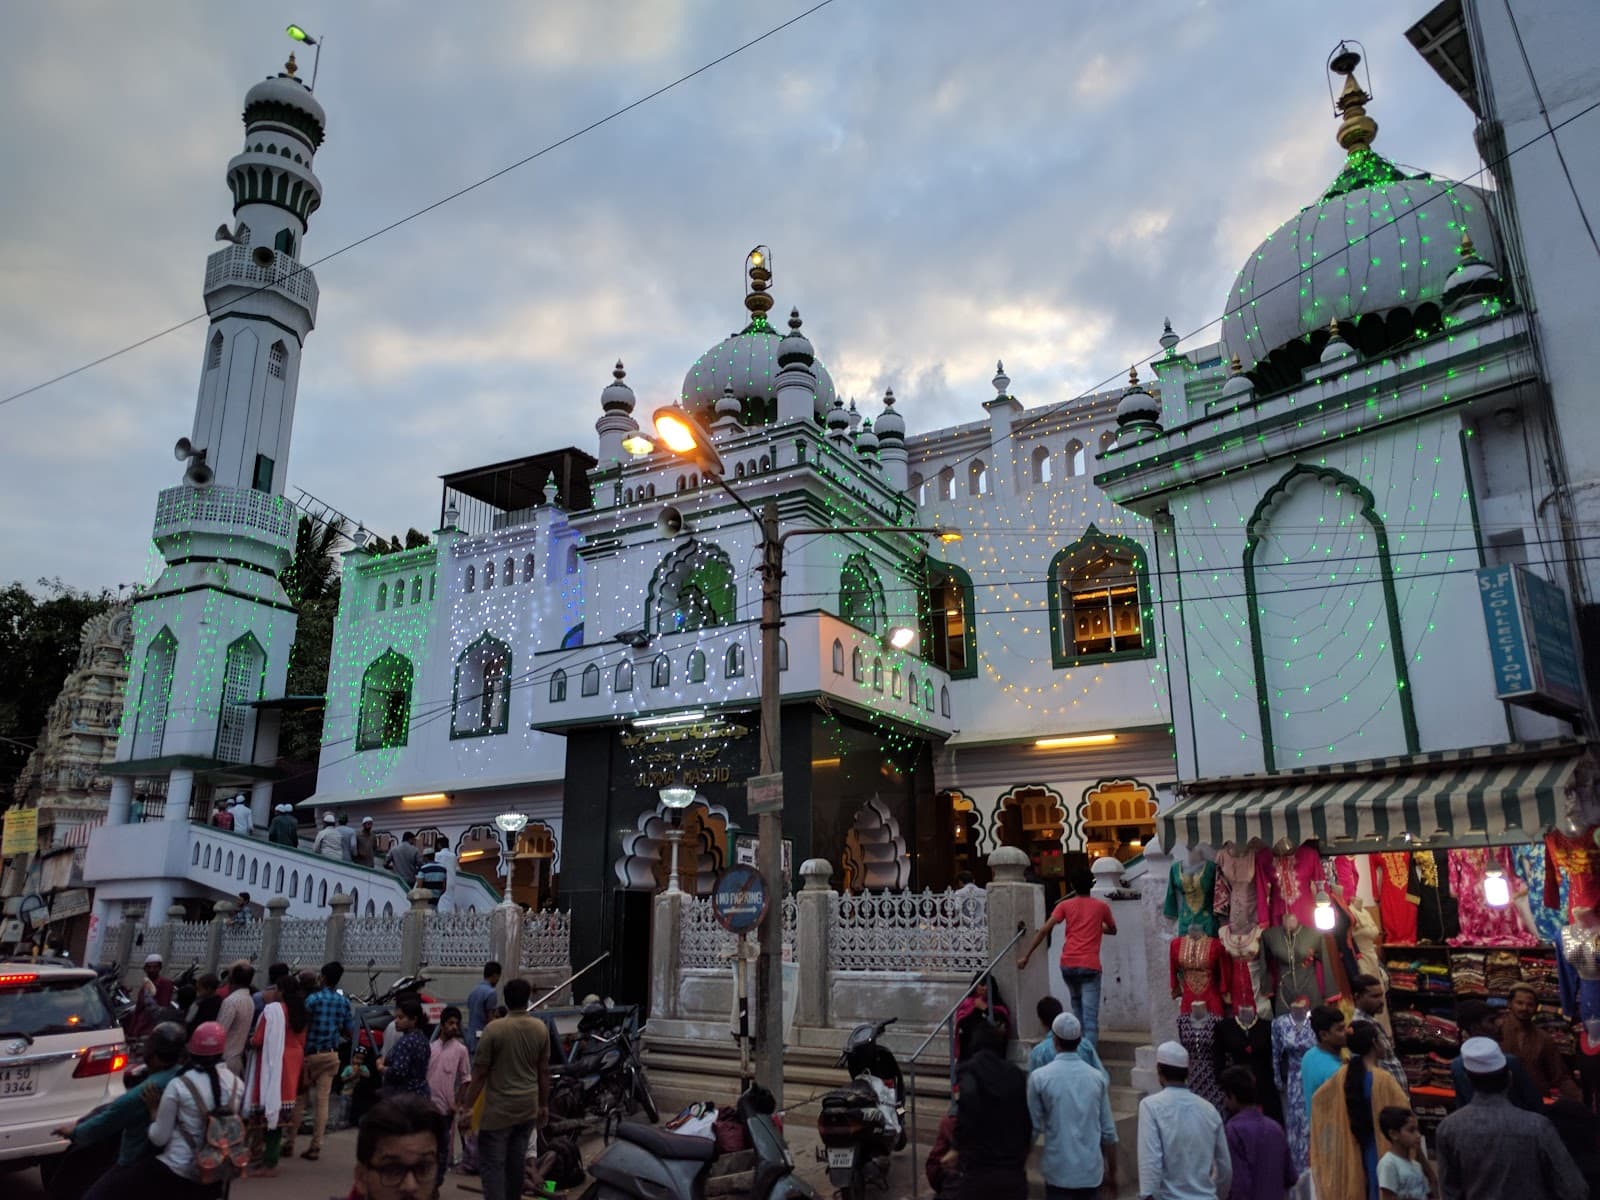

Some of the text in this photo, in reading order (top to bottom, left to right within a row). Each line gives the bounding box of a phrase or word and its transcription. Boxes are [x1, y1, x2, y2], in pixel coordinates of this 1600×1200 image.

[1489, 590, 1522, 691] COLLECTIONS
[635, 767, 730, 787] JUMMA MASJID
[730, 891, 762, 905] PARKING
[16, 1068, 31, 1081] 50
[4, 1080, 33, 1094] 3344
